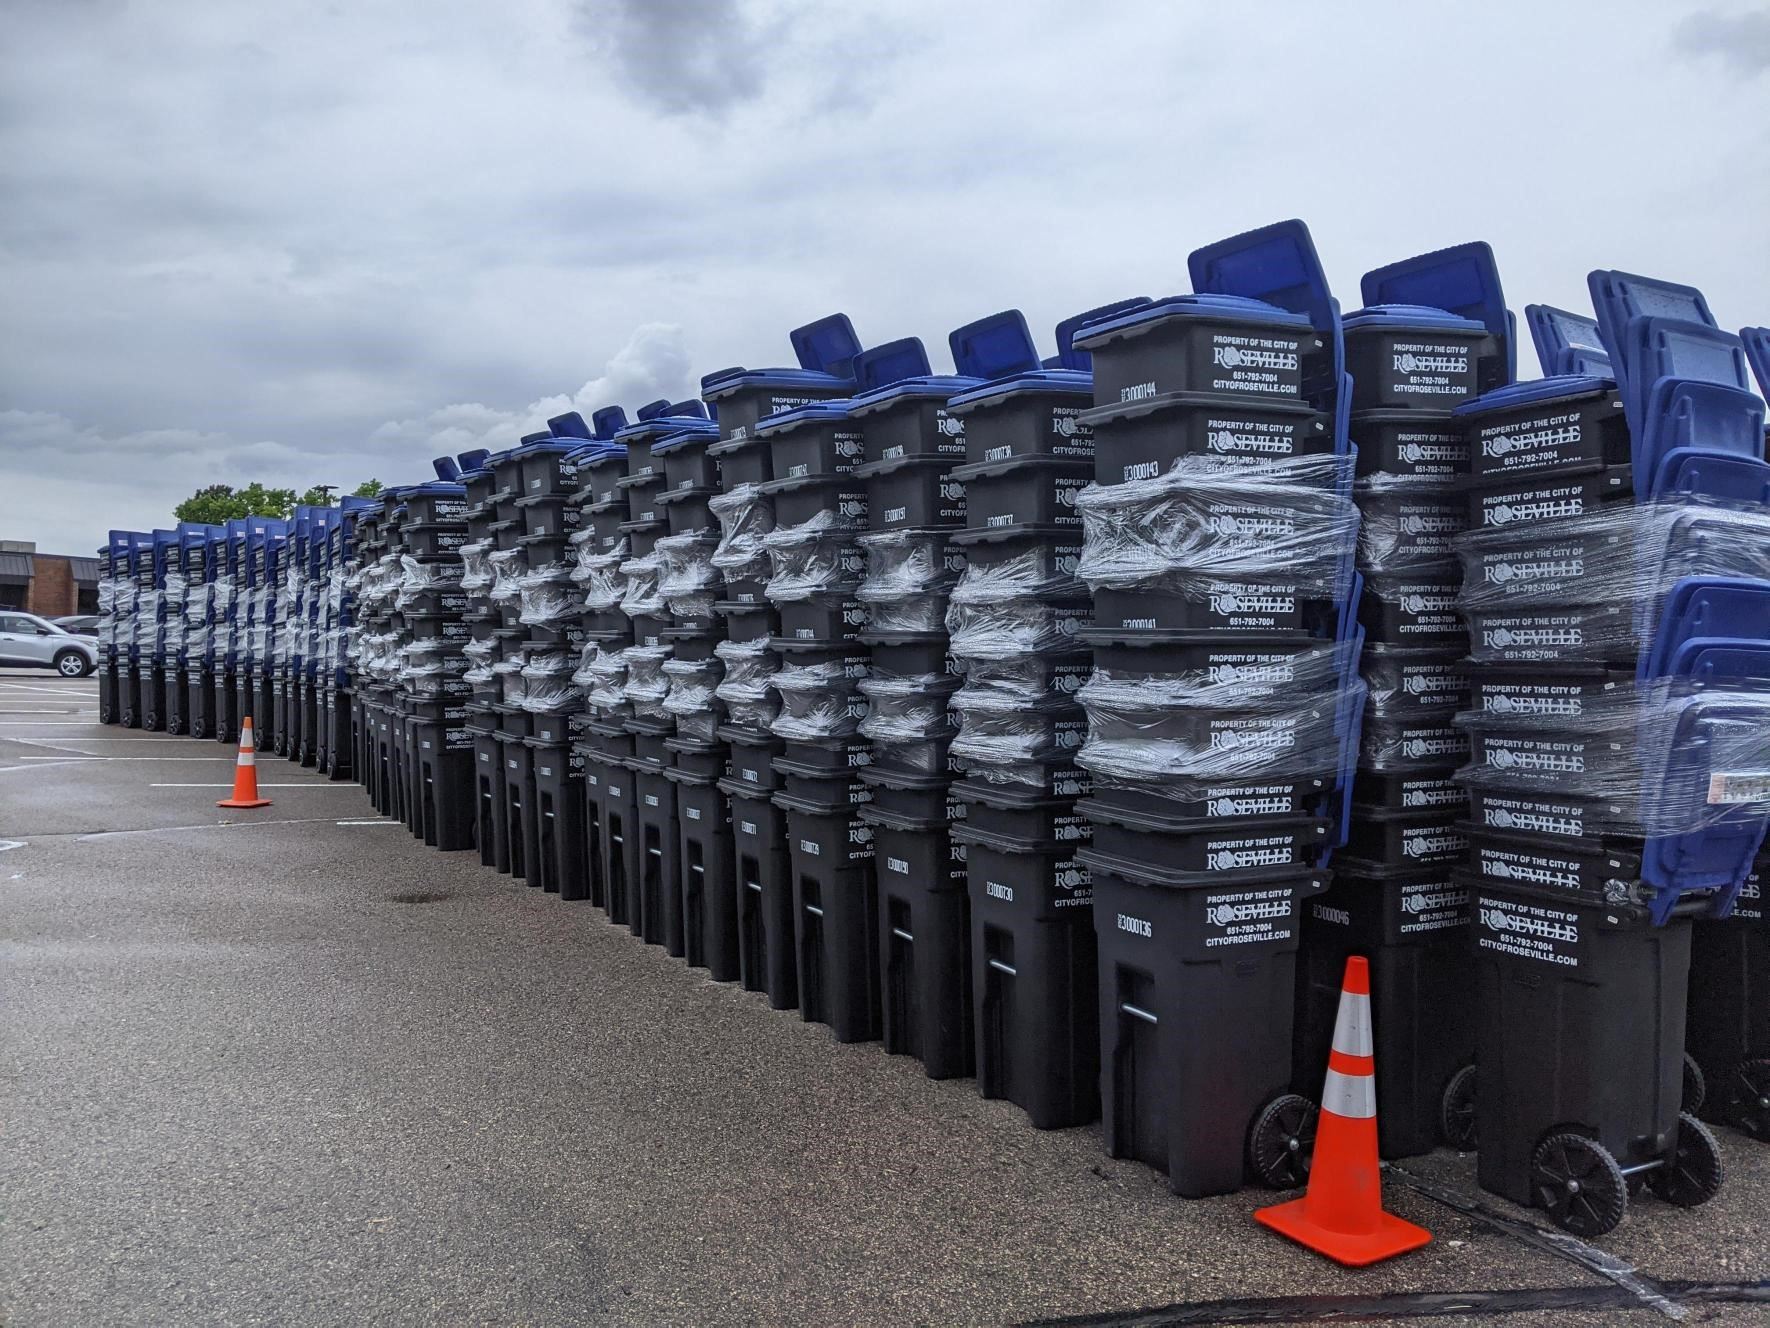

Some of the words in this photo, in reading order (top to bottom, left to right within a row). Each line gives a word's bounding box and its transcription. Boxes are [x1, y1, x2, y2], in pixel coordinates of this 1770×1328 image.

[1214, 333, 1248, 345] PROPERTY
[1249, 338, 1259, 346] OF
[1259, 339, 1272, 347] THE
[1273, 340, 1288, 349] CITY
[1394, 342, 1423, 352] PROPERTY
[1233, 371, 1278, 382] 651-792-7004
[1410, 376, 1449, 385] 651-792-7004
[1213, 379, 1297, 394] CITYOFROSEVILLE.COM
[1394, 385, 1467, 394] CITYOFROSEVILLE.COM
[1208, 418, 1243, 429] PROPERTY
[1244, 422, 1254, 430] OF
[1255, 423, 1268, 431] THE
[1269, 424, 1283, 432] CITY
[1481, 422, 1519, 436] PROPERTY
[1521, 421, 1532, 430] OF
[1533, 418, 1549, 428] THE
[1549, 415, 1567, 425] CITY
[1569, 413, 1580, 422] OF
[1504, 450, 1558, 466] 651-792-7004
[1055, 478, 1088, 486] PROPERTY
[1483, 492, 1521, 505] PROPERTY
[1523, 492, 1534, 500] OF
[1535, 489, 1551, 498] THE
[1552, 487, 1569, 496] CITY
[1571, 486, 1582, 495] OF
[1484, 551, 1521, 562] PROPERTY
[1523, 551, 1534, 559] OF
[1535, 549, 1551, 558] THE
[1552, 548, 1570, 557] CITY
[1572, 547, 1583, 555] OF
[1211, 581, 1246, 592] PROPERTY
[1246, 584, 1257, 592] OF
[1271, 585, 1286, 593] CITY
[1230, 618, 1274, 626] 651-792-7004
[1482, 617, 1520, 626] PROPERTY
[1533, 617, 1550, 625] THE
[1570, 616, 1581, 624] OF
[1210, 652, 1245, 662] PROPERTY
[1245, 654, 1256, 662] OF
[1505, 650, 1558, 659] 651-792-7004
[1482, 683, 1519, 693] PROPERTY
[1521, 685, 1532, 693] OF
[1550, 686, 1568, 694] CITY
[1211, 719, 1246, 728] PROPERTY
[1485, 737, 1522, 748] PROPERTY
[1523, 740, 1534, 749] OF
[1535, 742, 1551, 750] THE
[1552, 742, 1571, 751] CITY
[1572, 744, 1584, 752] OF
[1208, 786, 1243, 796] PROPERTY
[1244, 787, 1254, 795] OF
[1255, 786, 1268, 794] THE
[1284, 785, 1293, 793] OF
[1483, 796, 1520, 809] PROPERTY
[1522, 801, 1533, 810] OF
[1534, 803, 1550, 812] THE
[1551, 805, 1569, 814] CITY
[1571, 807, 1583, 815] OF
[1208, 838, 1243, 850] PROPERTY
[1244, 839, 1254, 847] OF
[1255, 838, 1268, 846] THE
[1269, 837, 1283, 845] CITY
[1284, 836, 1293, 844] OF
[1481, 848, 1518, 861] PROPERTY
[1519, 855, 1530, 863] OF
[1531, 857, 1547, 866] THE
[1548, 859, 1567, 869] CITY
[1568, 862, 1580, 871] OF
[1207, 892, 1243, 903] PROPERTY
[1243, 892, 1253, 900] OF
[1254, 891, 1267, 899] THE
[1268, 890, 1282, 898] CITY
[1283, 889, 1292, 897] OF
[1480, 896, 1516, 911] PROPERTY
[1518, 904, 1529, 914] OF
[1530, 907, 1546, 917] THE
[1547, 910, 1565, 920] CITY
[1566, 913, 1578, 922] OF
[1227, 923, 1272, 935] 651-792-7004
[1206, 930, 1291, 947] CITYOFROSEVILLE.COM
[1500, 934, 1553, 951] 651-792-7004
[1480, 938, 1578, 966] CITYOFROSEVILLE.COM
